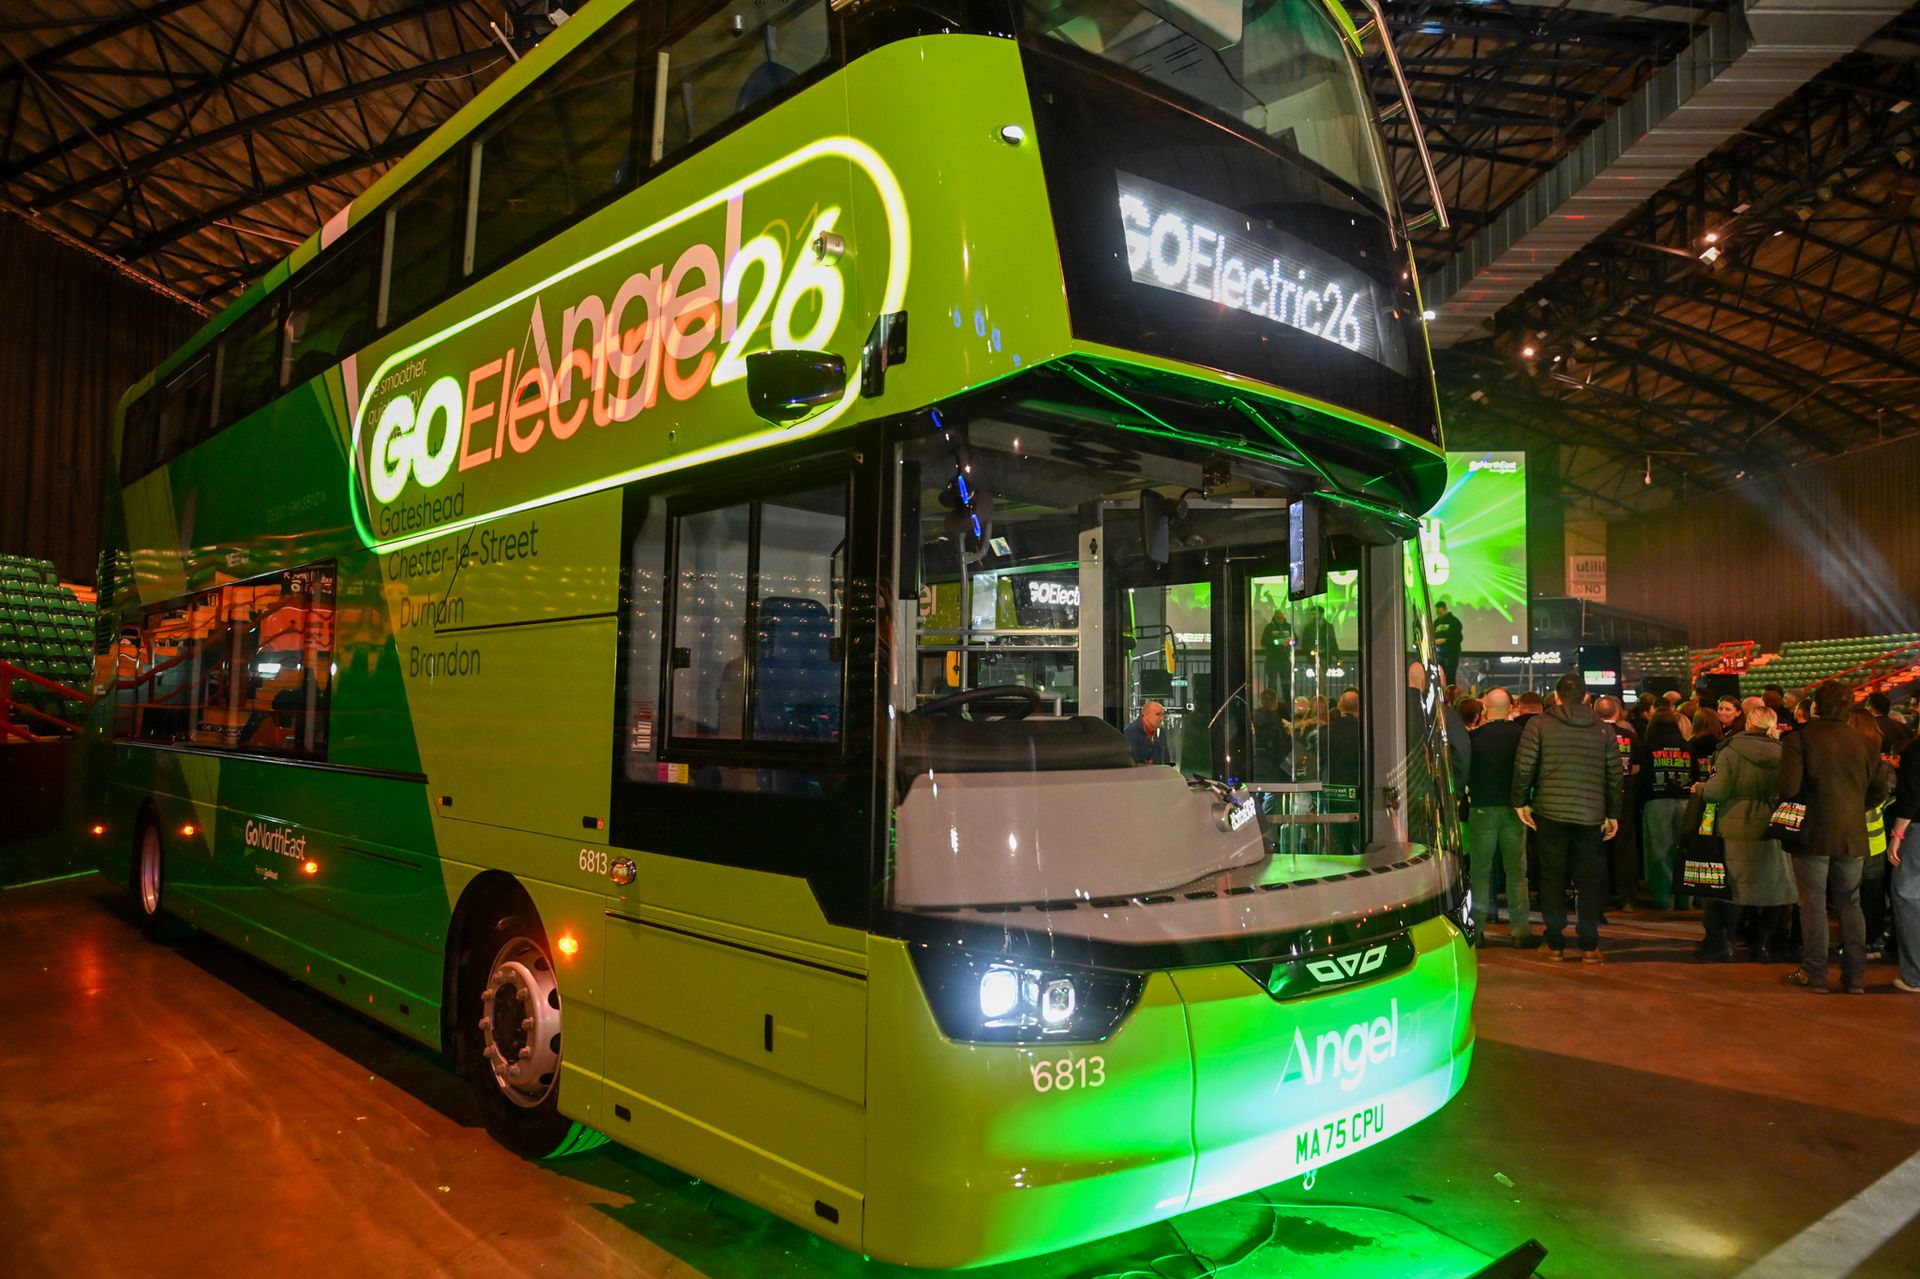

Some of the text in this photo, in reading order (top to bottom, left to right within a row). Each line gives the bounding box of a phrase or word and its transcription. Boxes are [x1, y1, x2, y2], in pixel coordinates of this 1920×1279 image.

[379, 482, 465, 537] Gateshead
[388, 520, 539, 582] Chester-le-Street
[400, 593, 464, 629] Durham
[409, 642, 481, 678] Brandon
[245, 820, 306, 861] GoNorthEast
[579, 848, 608, 875] 6813
[1273, 997, 1399, 1092] Angel
[1032, 1055, 1106, 1092] 6813
[1296, 1103, 1384, 1165] MA75 CPU
